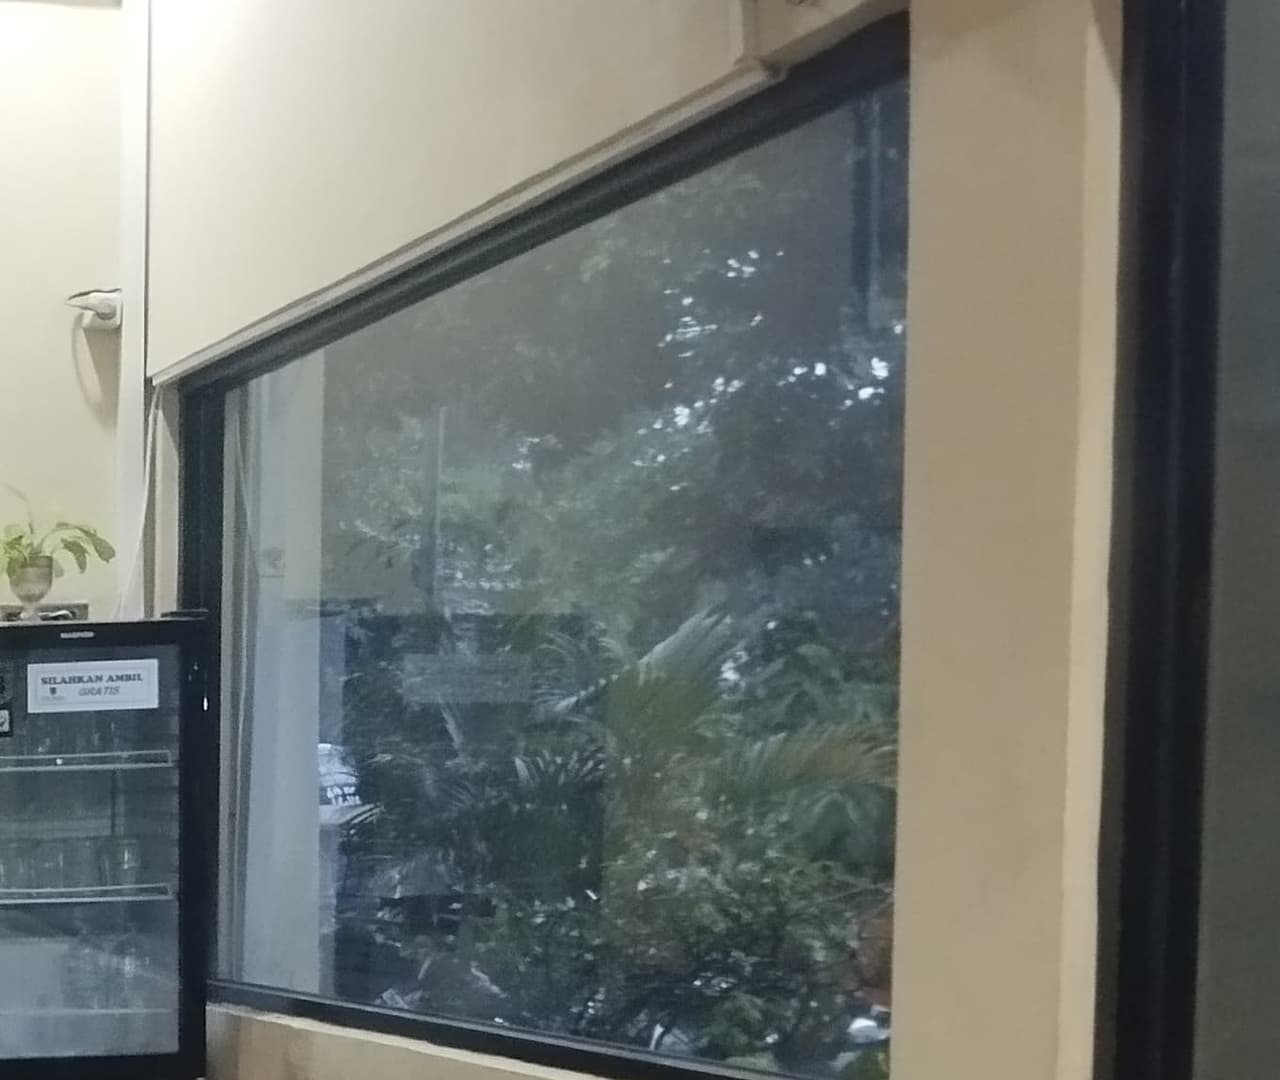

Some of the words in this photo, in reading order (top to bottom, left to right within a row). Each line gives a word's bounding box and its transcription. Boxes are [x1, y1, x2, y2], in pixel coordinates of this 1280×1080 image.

[40, 674, 104, 685] SILAHKAN
[106, 673, 144, 683] AMBIL
[78, 685, 121, 697] GRATIS
